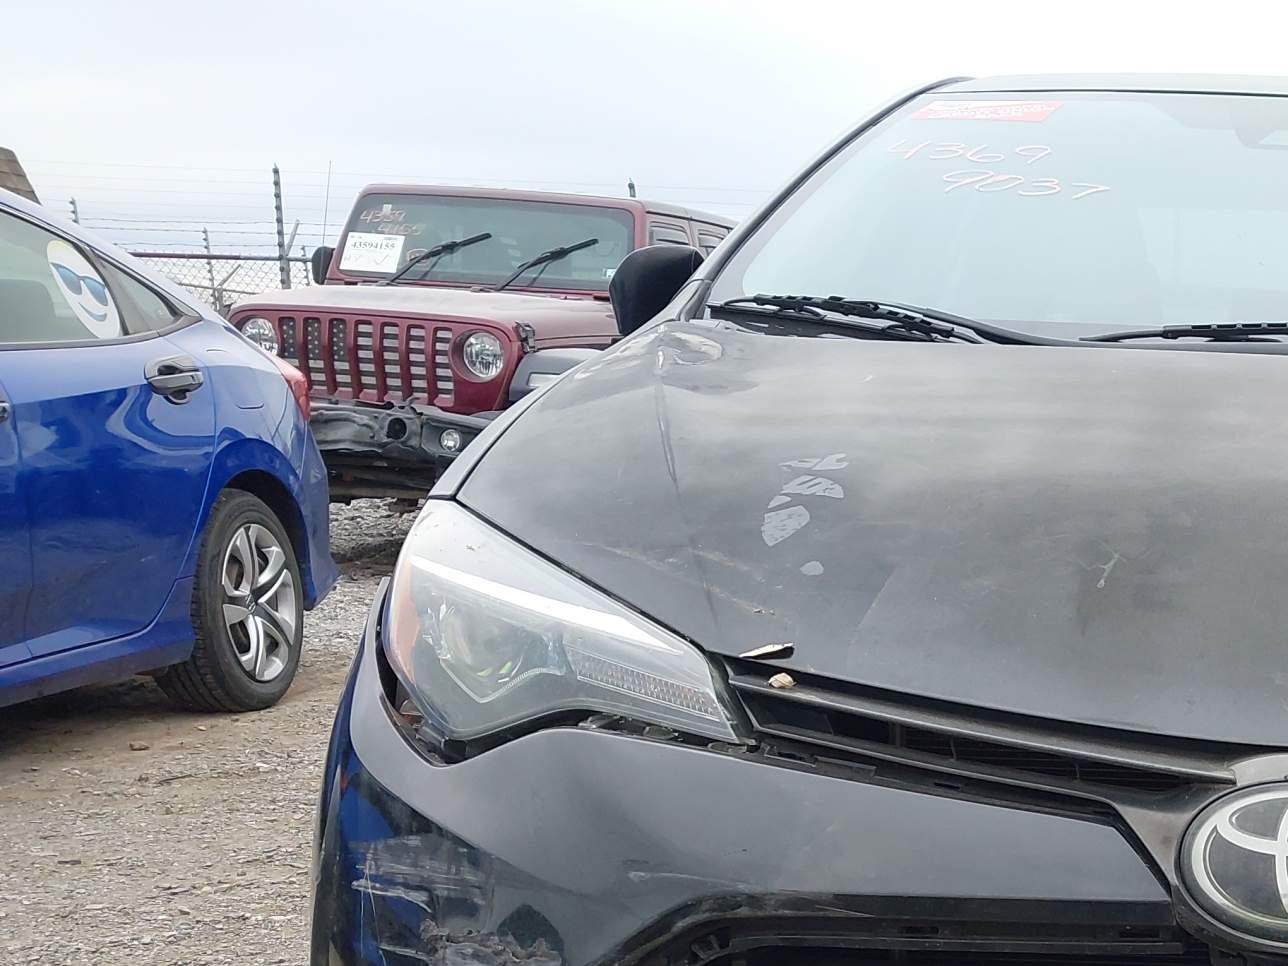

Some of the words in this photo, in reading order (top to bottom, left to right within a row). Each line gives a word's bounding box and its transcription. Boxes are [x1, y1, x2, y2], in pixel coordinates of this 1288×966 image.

[888, 140, 1052, 165] 4369
[943, 169, 1111, 200] 9037
[351, 241, 396, 250] 43594155
